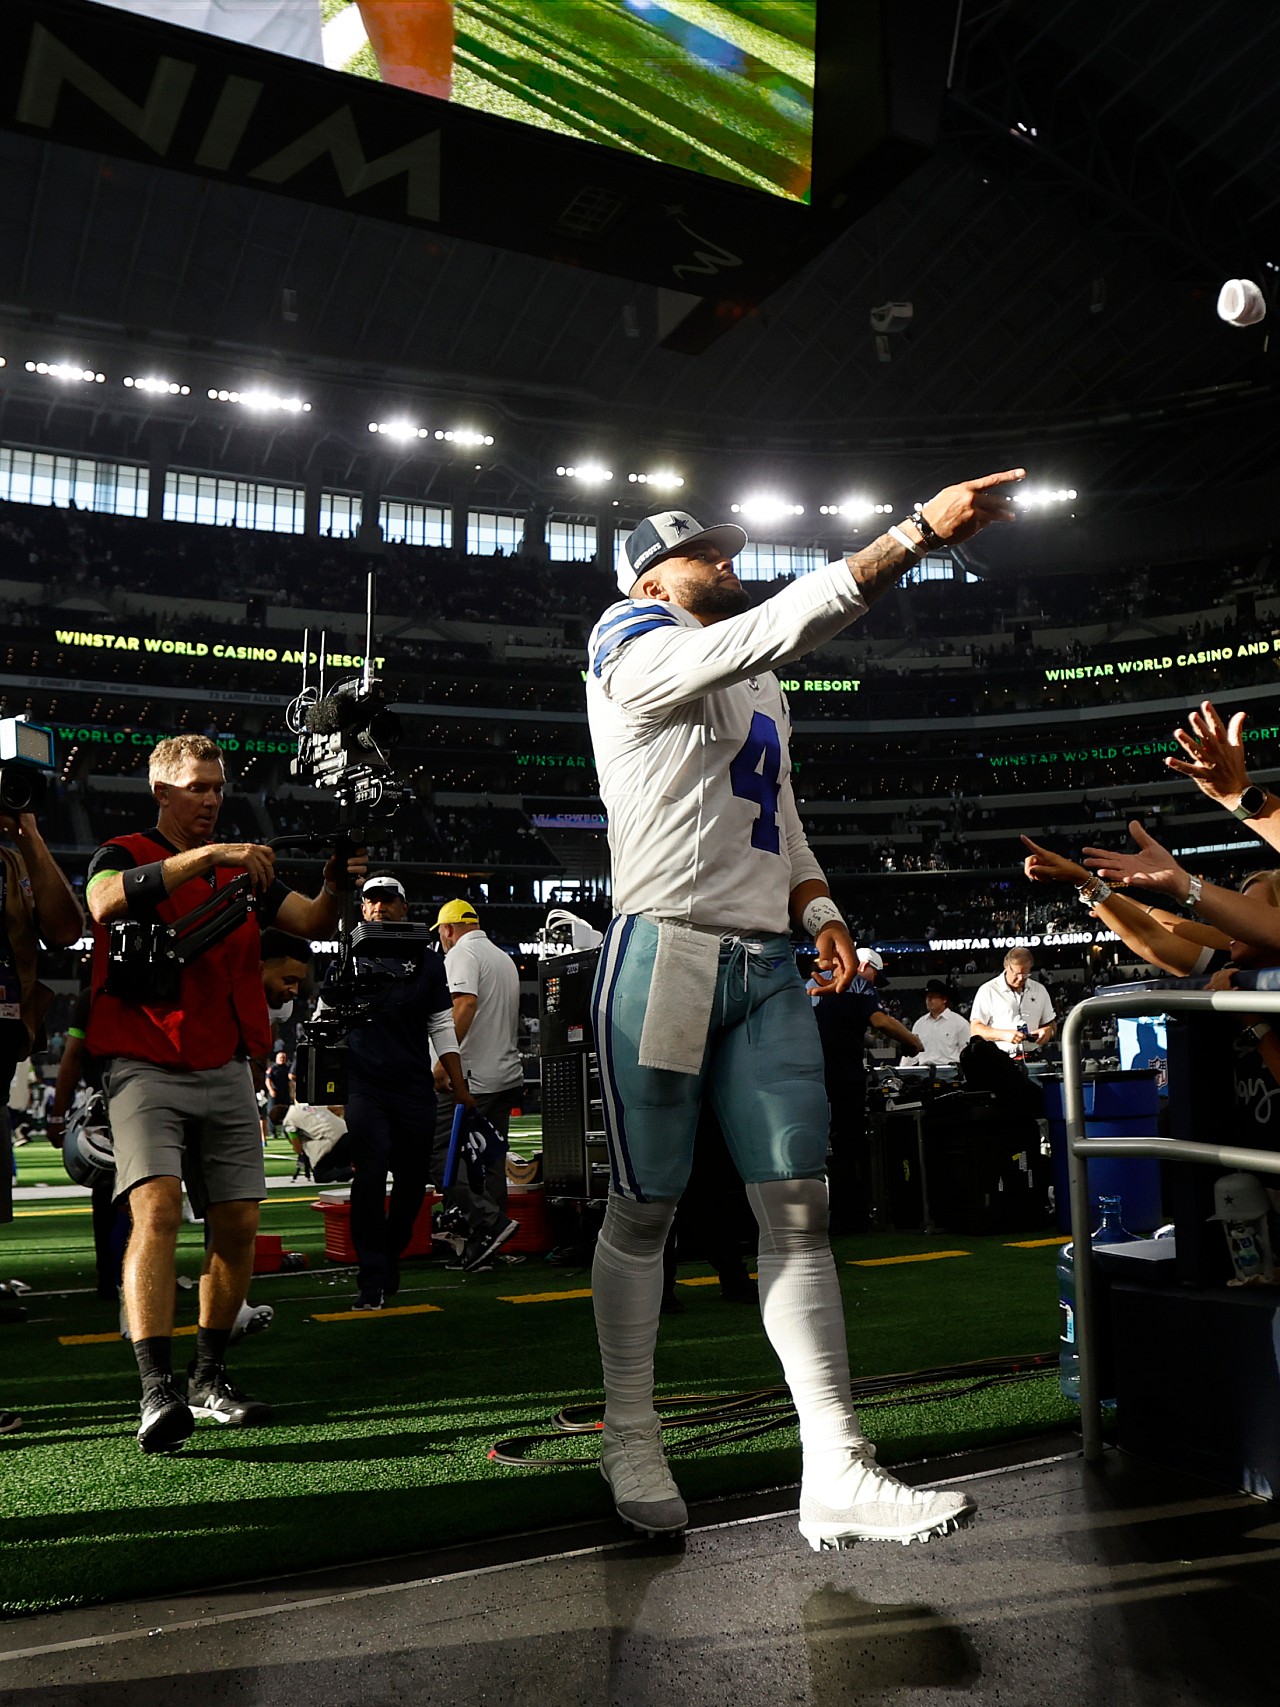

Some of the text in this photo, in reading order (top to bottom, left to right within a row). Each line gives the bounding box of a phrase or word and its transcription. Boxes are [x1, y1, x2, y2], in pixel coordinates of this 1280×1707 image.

[55, 630, 386, 670] WINSTAR WORLD CASINO AND RESOT
[1045, 663, 1114, 681] WINSTAR
[1117, 657, 1173, 674] WORLD
[1176, 648, 1233, 667] CASINO
[1237, 641, 1270, 657] AND
[780, 680, 861, 691] ND RESORT
[58, 727, 126, 745] WORLD
[215, 738, 240, 751] ND
[245, 739, 298, 755] RESOR
[1242, 727, 1280, 742] SORT
[515, 754, 588, 769] WINSTAR
[989, 740, 1179, 767] WINSTAR WORLD CASINO
[730, 711, 782, 855] 4
[310, 940, 339, 954] ORT
[929, 938, 990, 951] WINSTAR
[992, 936, 1041, 949] WORLD
[1043, 932, 1093, 946] CASINO
